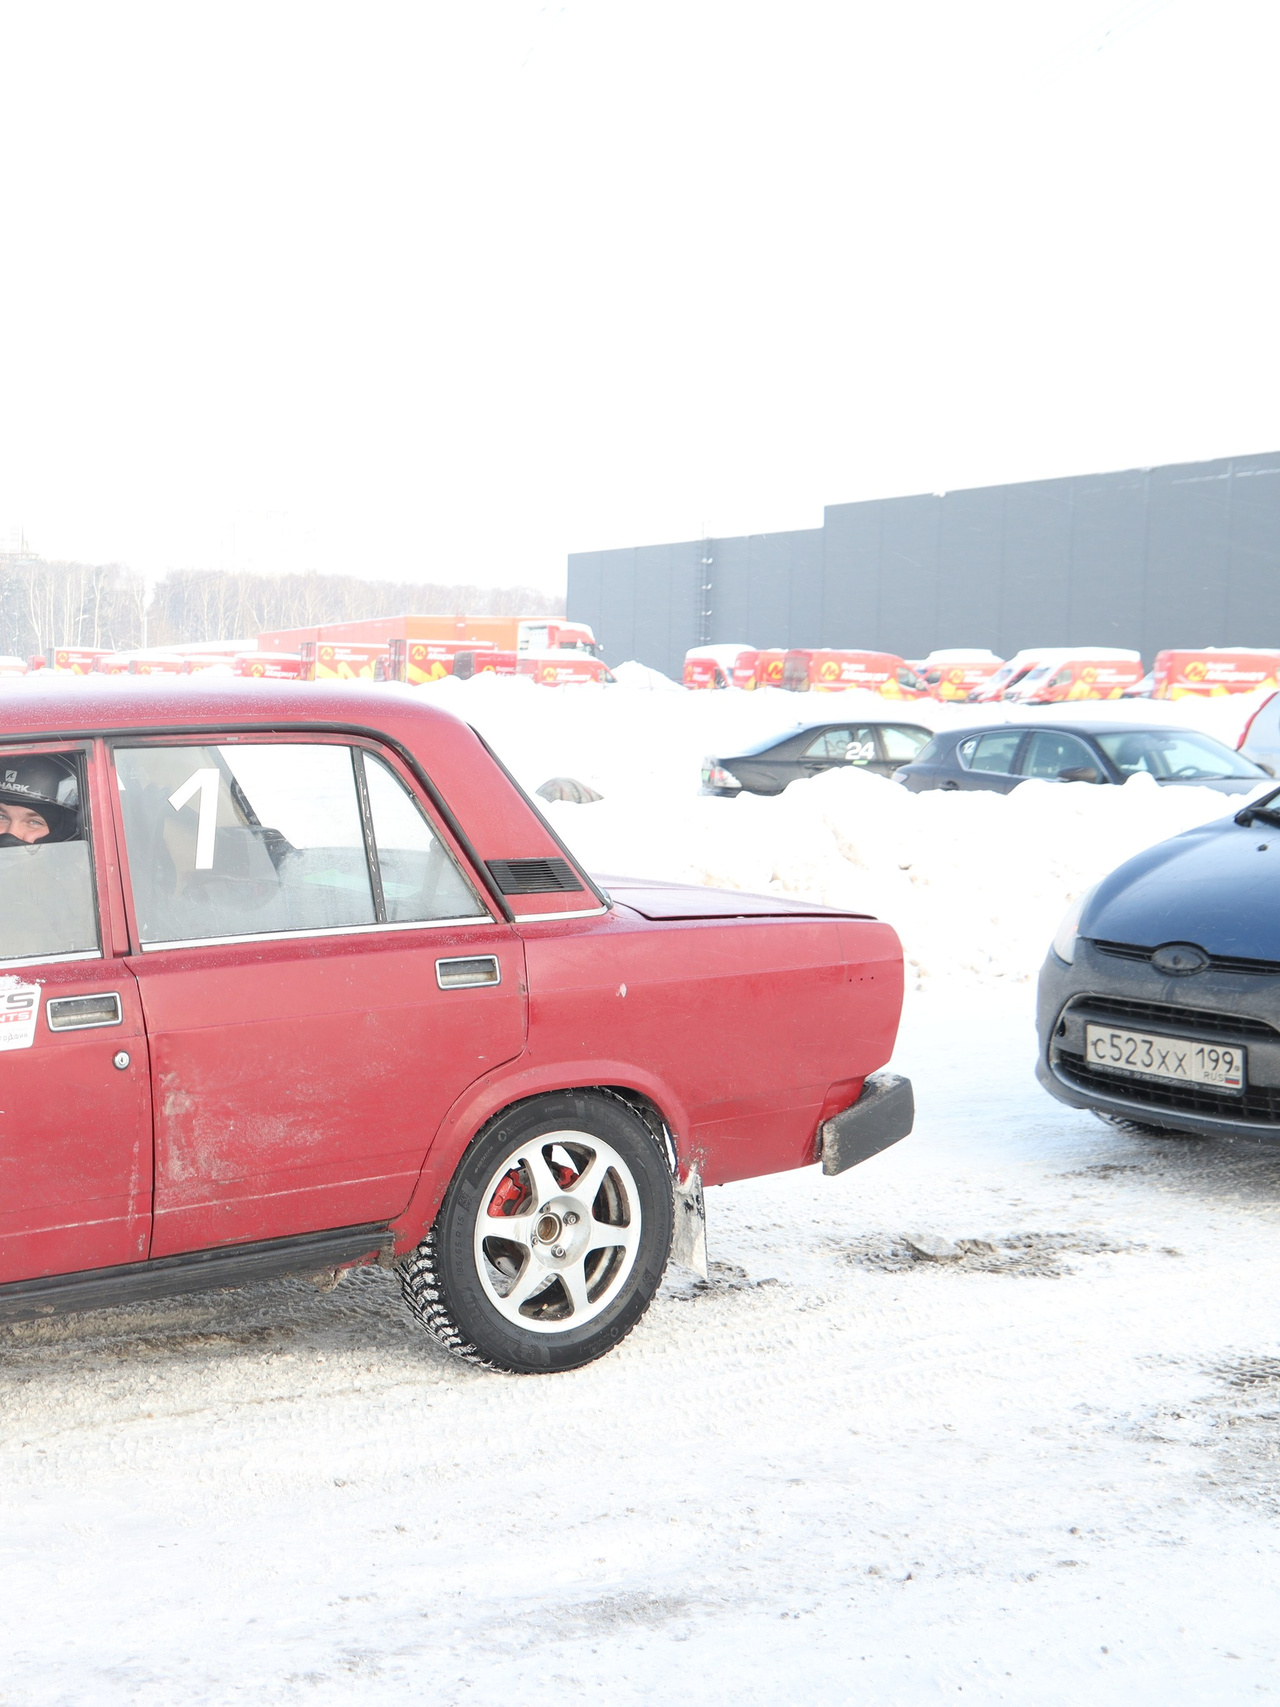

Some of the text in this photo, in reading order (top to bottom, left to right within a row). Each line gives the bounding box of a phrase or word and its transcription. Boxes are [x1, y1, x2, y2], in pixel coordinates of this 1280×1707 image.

[845, 741, 876, 760] 24
[962, 740, 978, 754] 12
[167, 768, 220, 870] 1
[1195, 1047, 1234, 1073] 199
[1203, 1071, 1224, 1083] RUS
[457, 1216, 465, 1227] 15
[455, 1241, 464, 1278] 185/65
